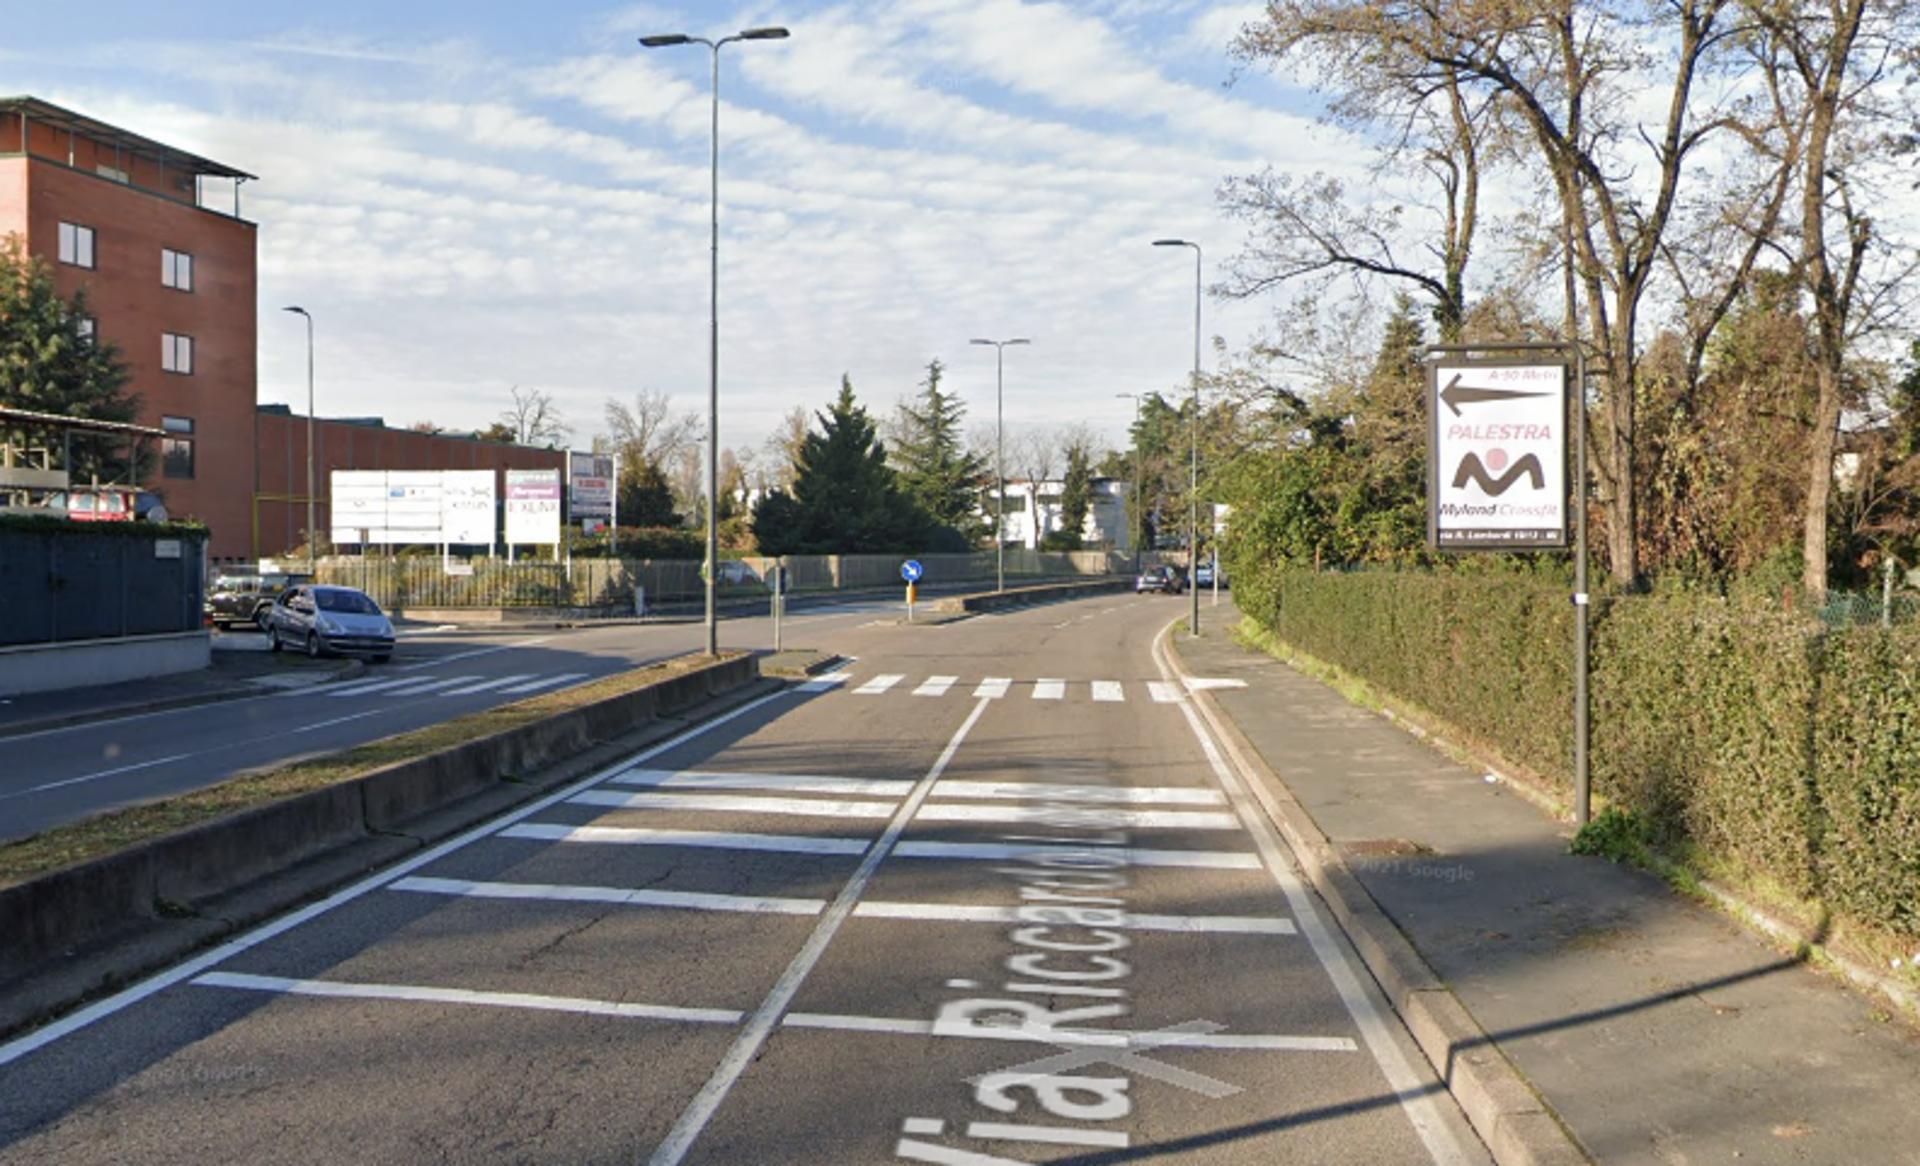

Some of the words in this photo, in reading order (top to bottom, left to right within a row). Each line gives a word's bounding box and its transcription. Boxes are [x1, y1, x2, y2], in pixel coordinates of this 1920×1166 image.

[1447, 424, 1552, 440] PALESTRA
[1440, 503, 1497, 517] Myland
[1500, 503, 1558, 517] Crossfit
